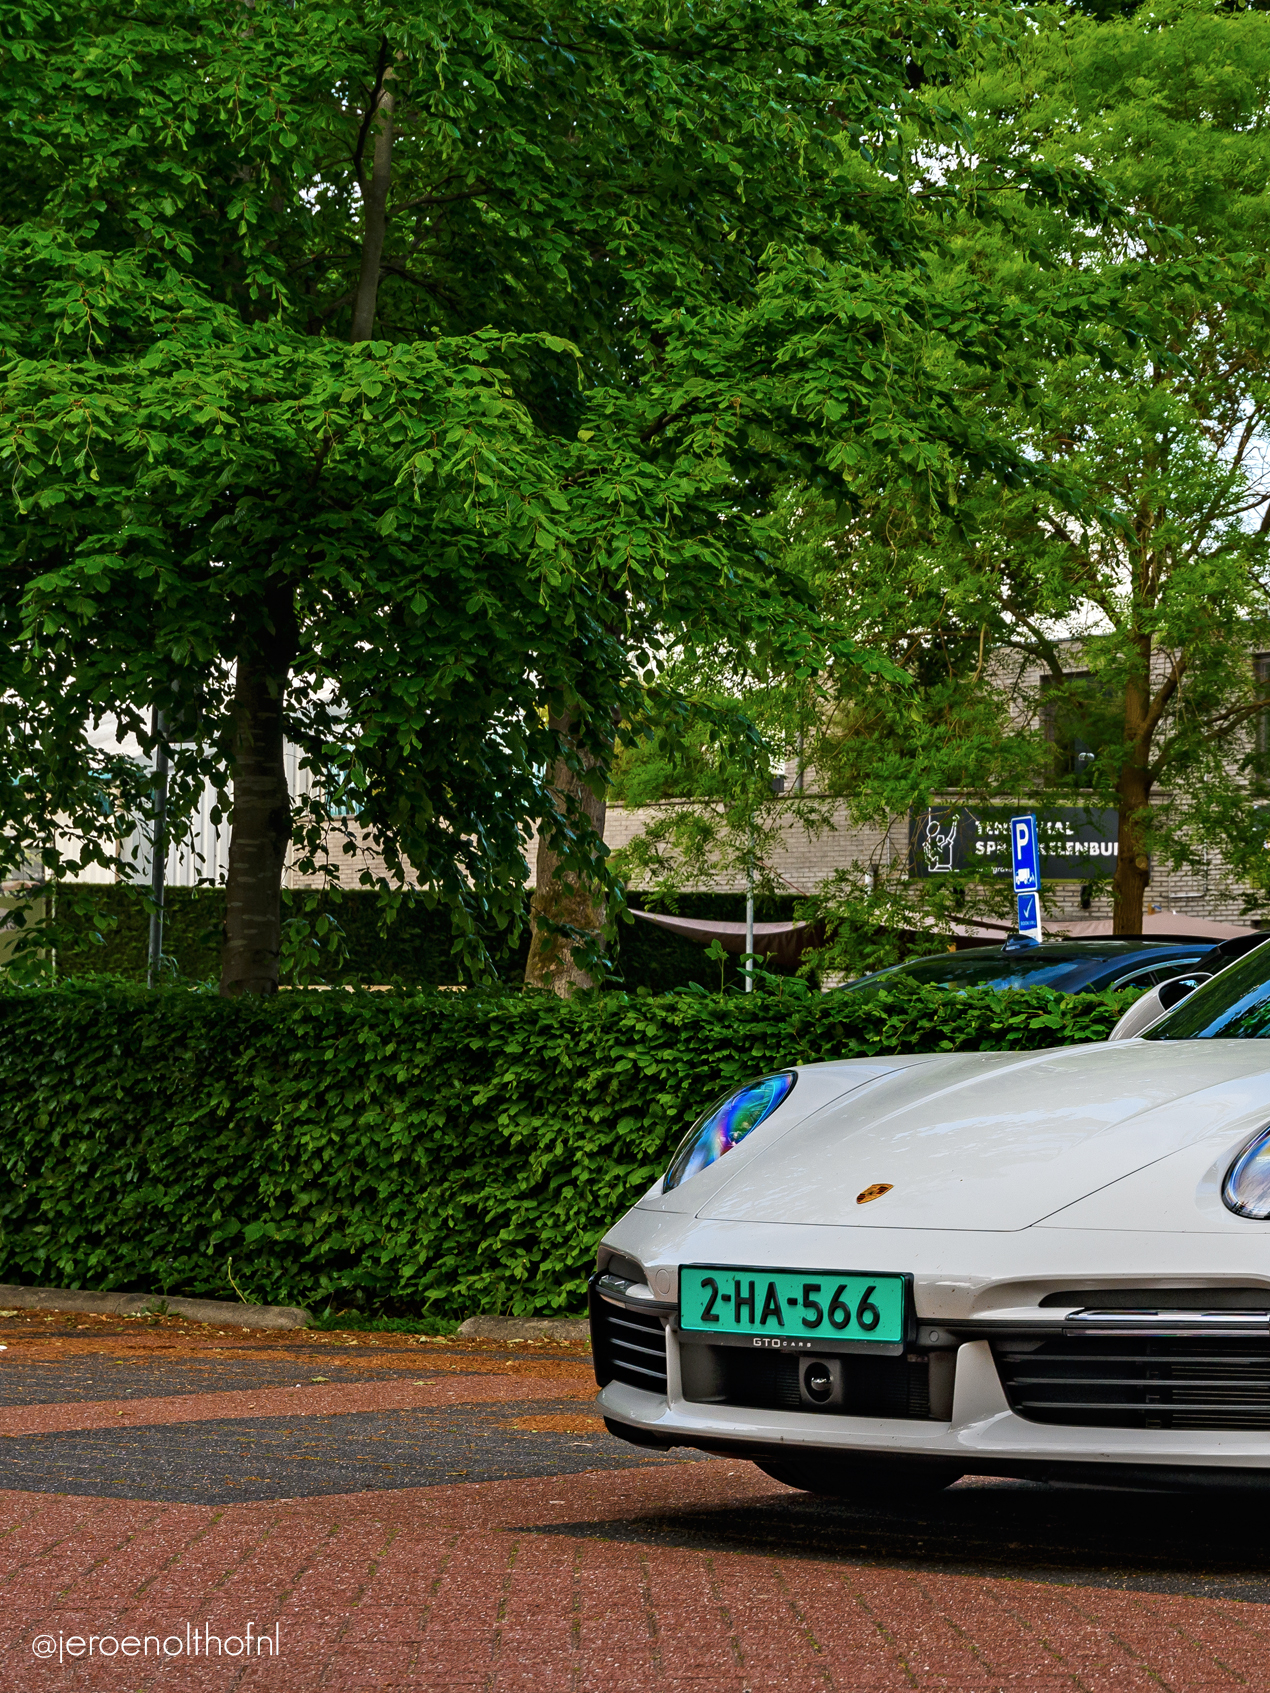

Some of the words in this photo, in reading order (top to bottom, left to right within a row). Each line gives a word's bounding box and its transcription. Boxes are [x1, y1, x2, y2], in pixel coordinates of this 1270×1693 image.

[1016, 823, 1029, 860] P
[700, 1277, 881, 1331] 2-HA-566
[753, 1337, 780, 1348] GTO
